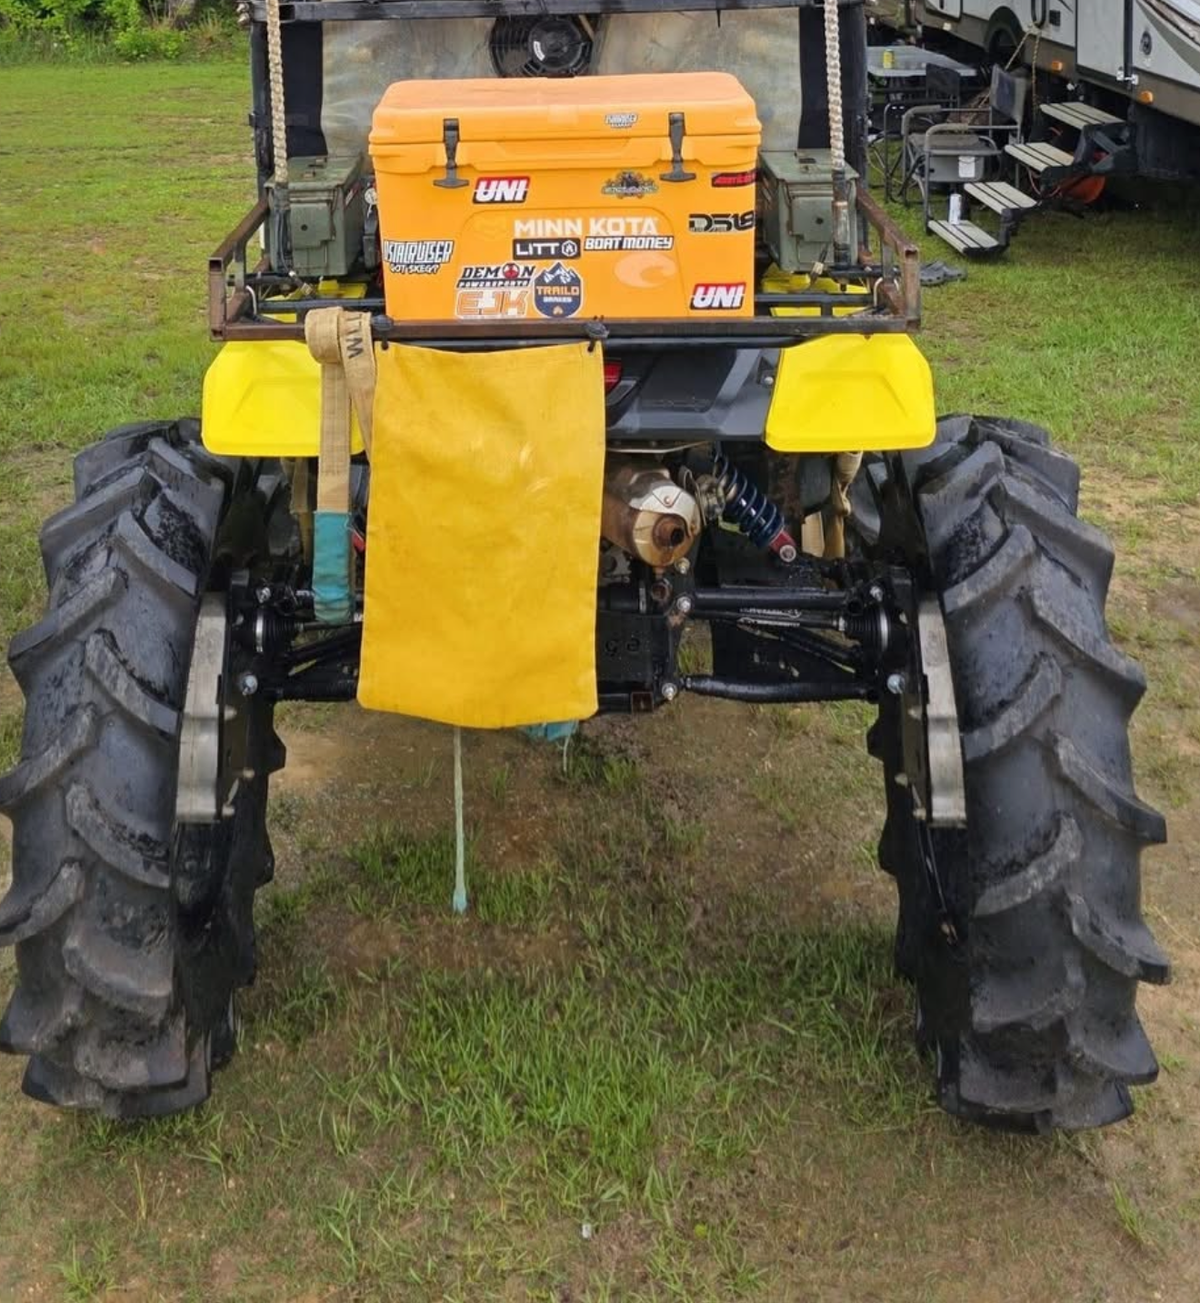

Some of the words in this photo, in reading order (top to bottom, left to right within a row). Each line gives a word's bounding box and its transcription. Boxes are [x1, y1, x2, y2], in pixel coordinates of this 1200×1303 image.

[476, 179, 528, 202] UNI
[513, 218, 583, 237] MINN
[589, 216, 658, 236] KOTA
[516, 243, 560, 256] LITT
[585, 238, 621, 250] BOAT
[622, 237, 674, 249] MONEY
[693, 285, 744, 307] UNI
